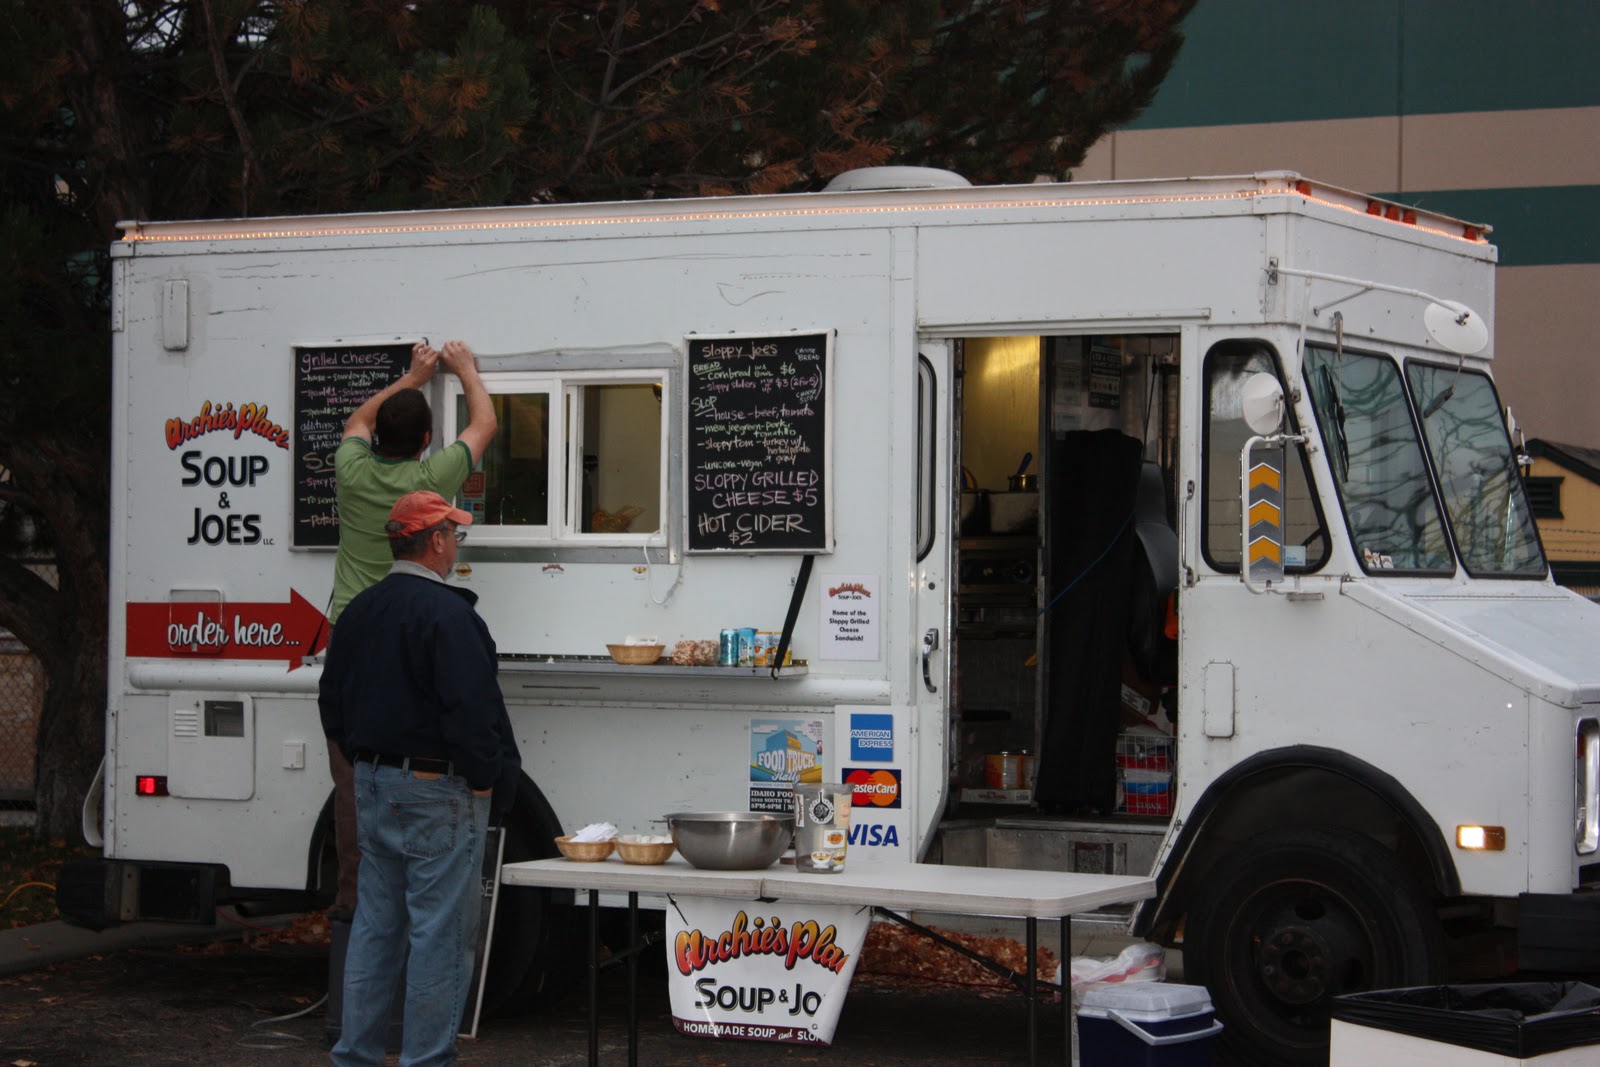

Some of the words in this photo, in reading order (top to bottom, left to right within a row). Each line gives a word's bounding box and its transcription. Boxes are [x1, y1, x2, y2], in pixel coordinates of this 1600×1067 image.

[301, 352, 337, 373] grilled
[341, 351, 393, 365] cheese
[780, 362, 796, 376] $6
[775, 377, 789, 389] $3
[181, 450, 269, 488] SOUP
[694, 473, 748, 491] SLOPPY
[752, 470, 819, 488] GRILLED
[218, 491, 231, 509] &
[712, 490, 791, 509] CHEESE
[792, 488, 818, 506] $5
[187, 508, 262, 546] JOES
[698, 513, 731, 536] HOT
[736, 513, 811, 533] CIDER
[728, 530, 756, 546] $2
[168, 611, 230, 647] order
[851, 730, 890, 738] AMERICAN
[858, 740, 893, 748] EXPRESS
[758, 750, 785, 773] FOOD
[786, 749, 815, 775] TRUCK
[772, 770, 801, 786] Rally
[846, 824, 899, 846] VISA
[695, 978, 775, 1013] SOUP
[779, 988, 789, 1003] &
[789, 983, 823, 1016] JO
[684, 1022, 744, 1036] HOMEMADE
[748, 1027, 776, 1038] SOUP
[778, 1029, 793, 1040] and
